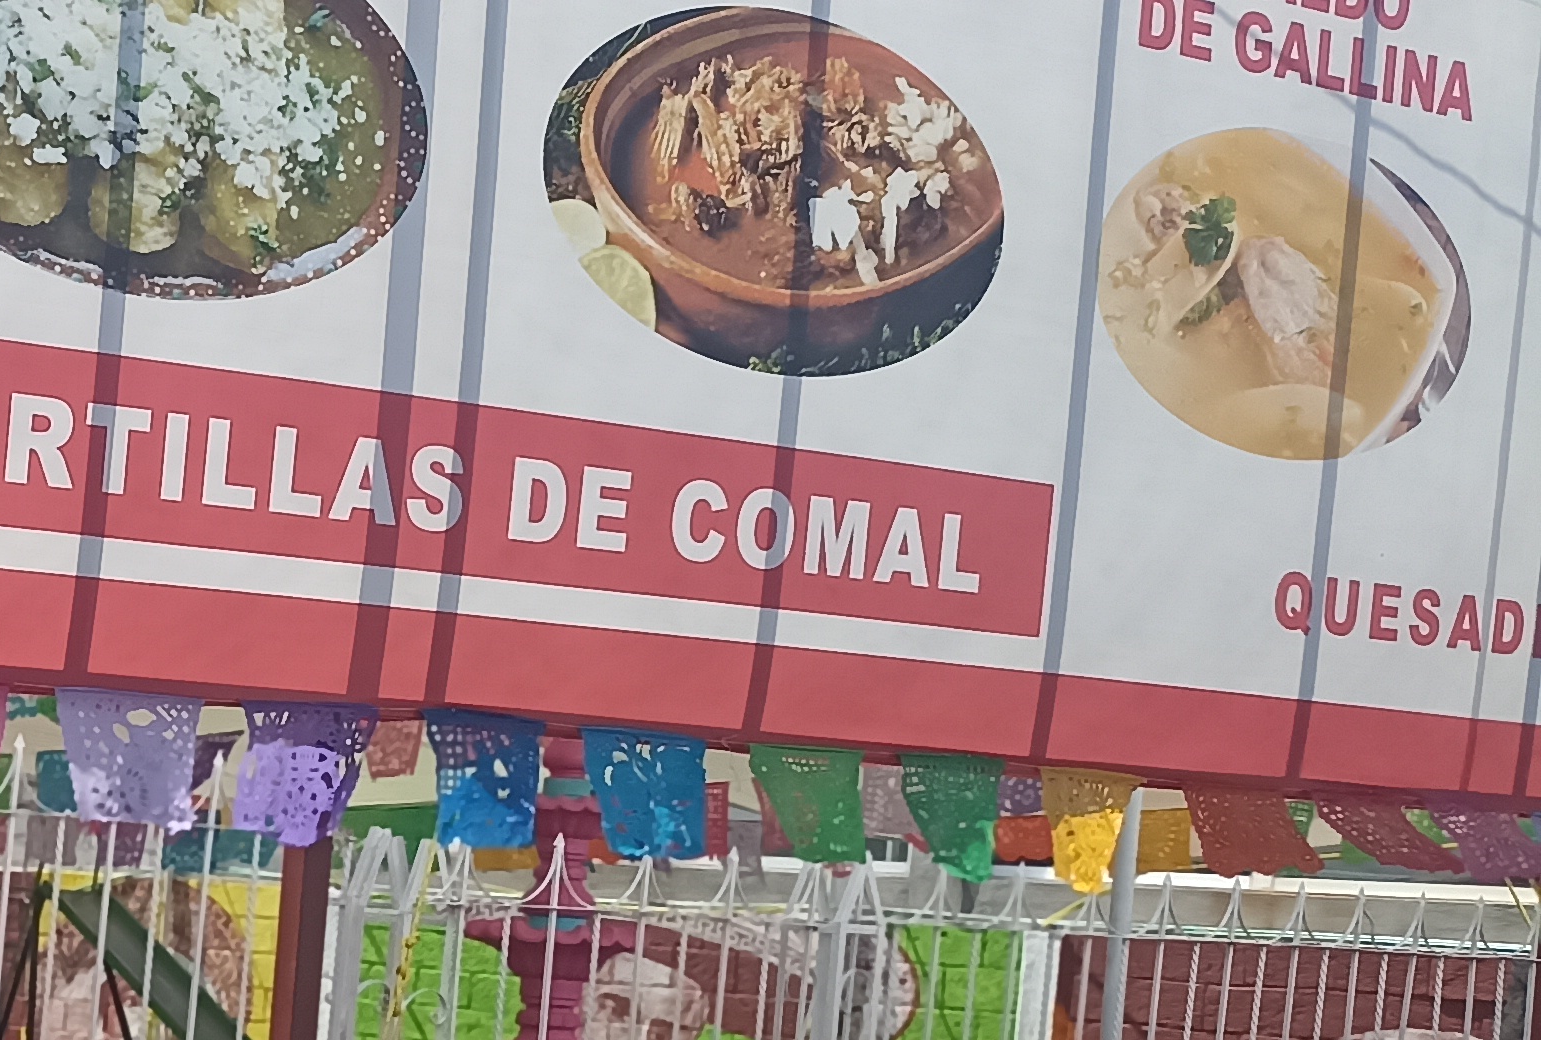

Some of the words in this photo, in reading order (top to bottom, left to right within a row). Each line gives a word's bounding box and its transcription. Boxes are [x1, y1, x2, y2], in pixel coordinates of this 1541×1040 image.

[1138, 0, 1215, 61] DE
[1234, 12, 1472, 121] GALLINA
[508, 458, 633, 552] DE
[672, 481, 980, 594] COMAL
